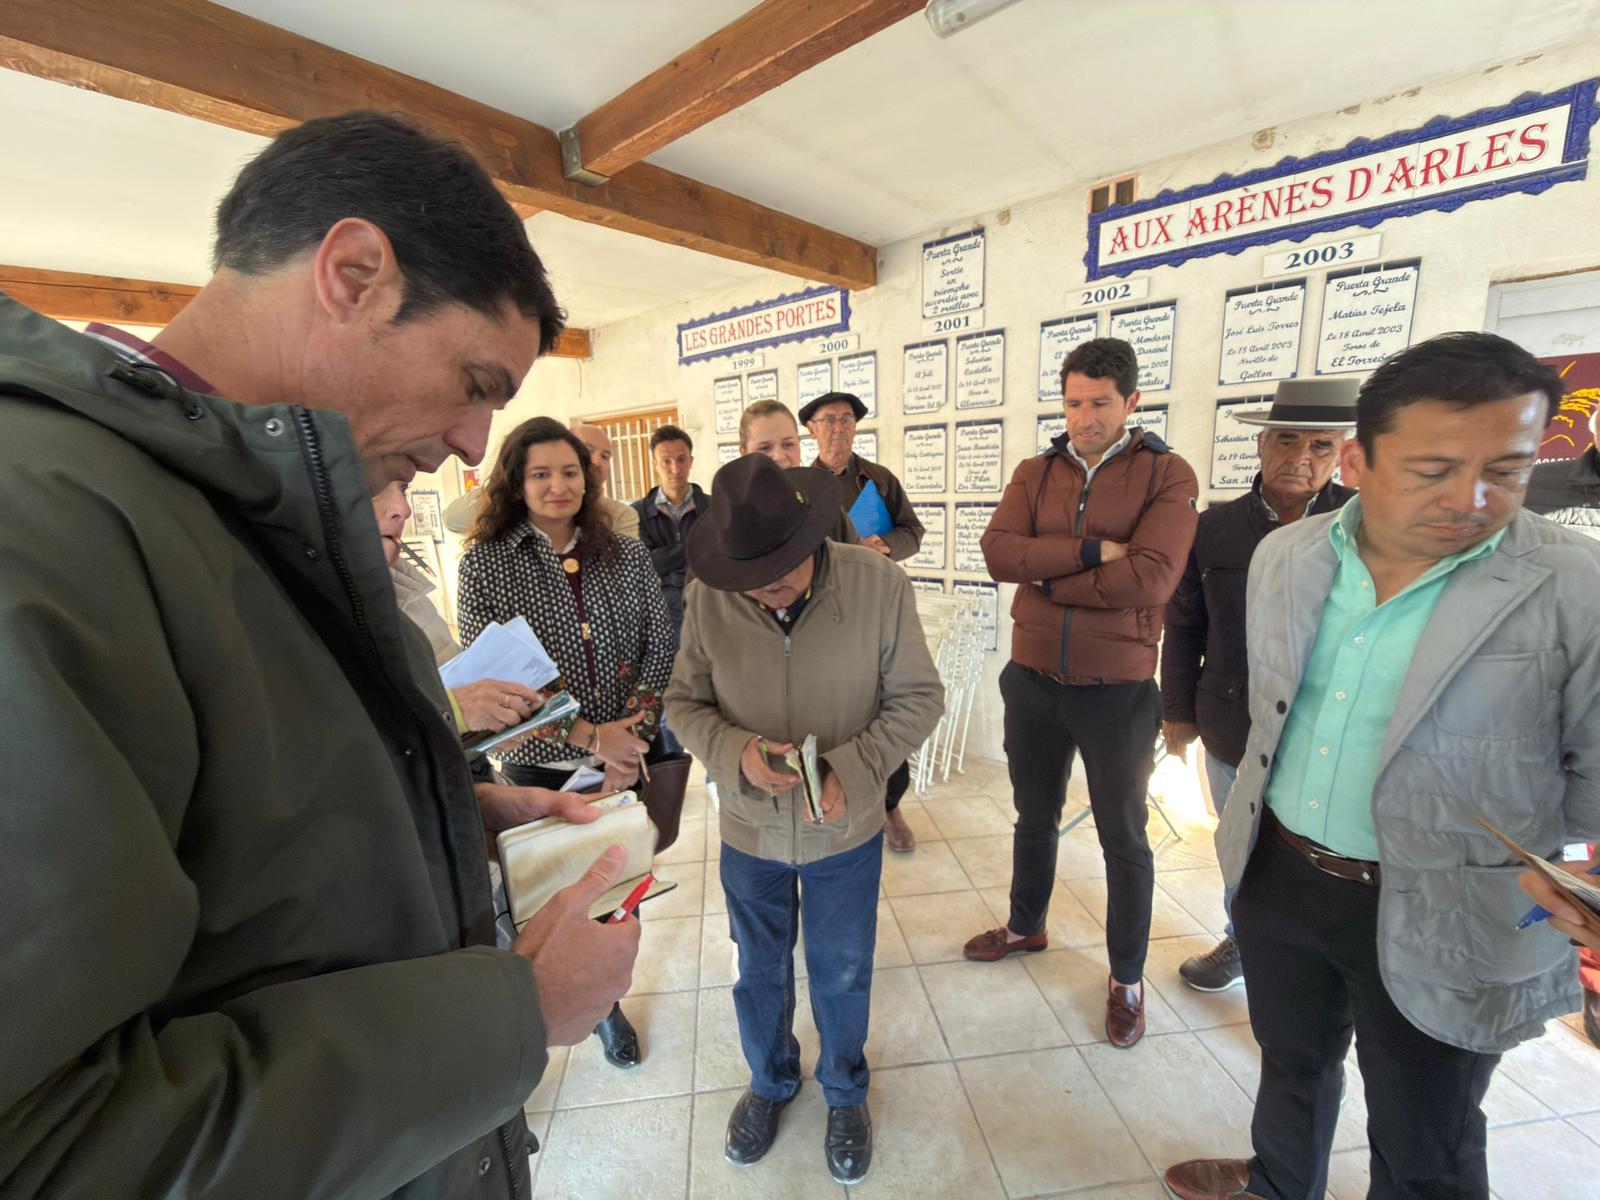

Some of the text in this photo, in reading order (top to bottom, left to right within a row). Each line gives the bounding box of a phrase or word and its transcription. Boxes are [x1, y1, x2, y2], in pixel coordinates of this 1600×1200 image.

[1107, 122, 1549, 255] AUX ARÈNES D'ARLES
[926, 239, 981, 261] Puerta Grande
[1284, 242, 1354, 269] 2003
[940, 266, 964, 278] Sortie
[1336, 272, 1411, 292] Puerta Grande
[934, 281, 970, 297] triomphe
[960, 291, 979, 299] avec
[1081, 284, 1131, 305] 2002
[1234, 294, 1299, 311] Puerta Grande
[932, 306, 939, 314] 2
[1370, 302, 1407, 317] Tejela
[684, 298, 837, 351] LES GRANDES PORTES
[934, 315, 970, 332] 2001
[1117, 314, 1170, 329] Puerta Grande
[1047, 325, 1093, 338] Puerta Grande
[1224, 320, 1299, 339] José Luis Torres
[1325, 324, 1403, 341] Le 18 Avril 2003
[819, 339, 848, 353] 2000
[960, 341, 979, 351] Puerta
[1133, 334, 1171, 345] Mendoza
[1227, 348, 1237, 356] Le
[1248, 342, 1270, 353] Avril
[1271, 341, 1293, 350] 2003
[1342, 341, 1381, 352] Toros de
[732, 358, 755, 370] 1999
[1150, 361, 1169, 369] 2002
[1268, 355, 1279, 363] de
[1331, 356, 1345, 368] El
[964, 365, 992, 376] Castella
[1136, 417, 1163, 426] Grande
[1228, 453, 1238, 461] 19
[1219, 475, 1238, 485] San
